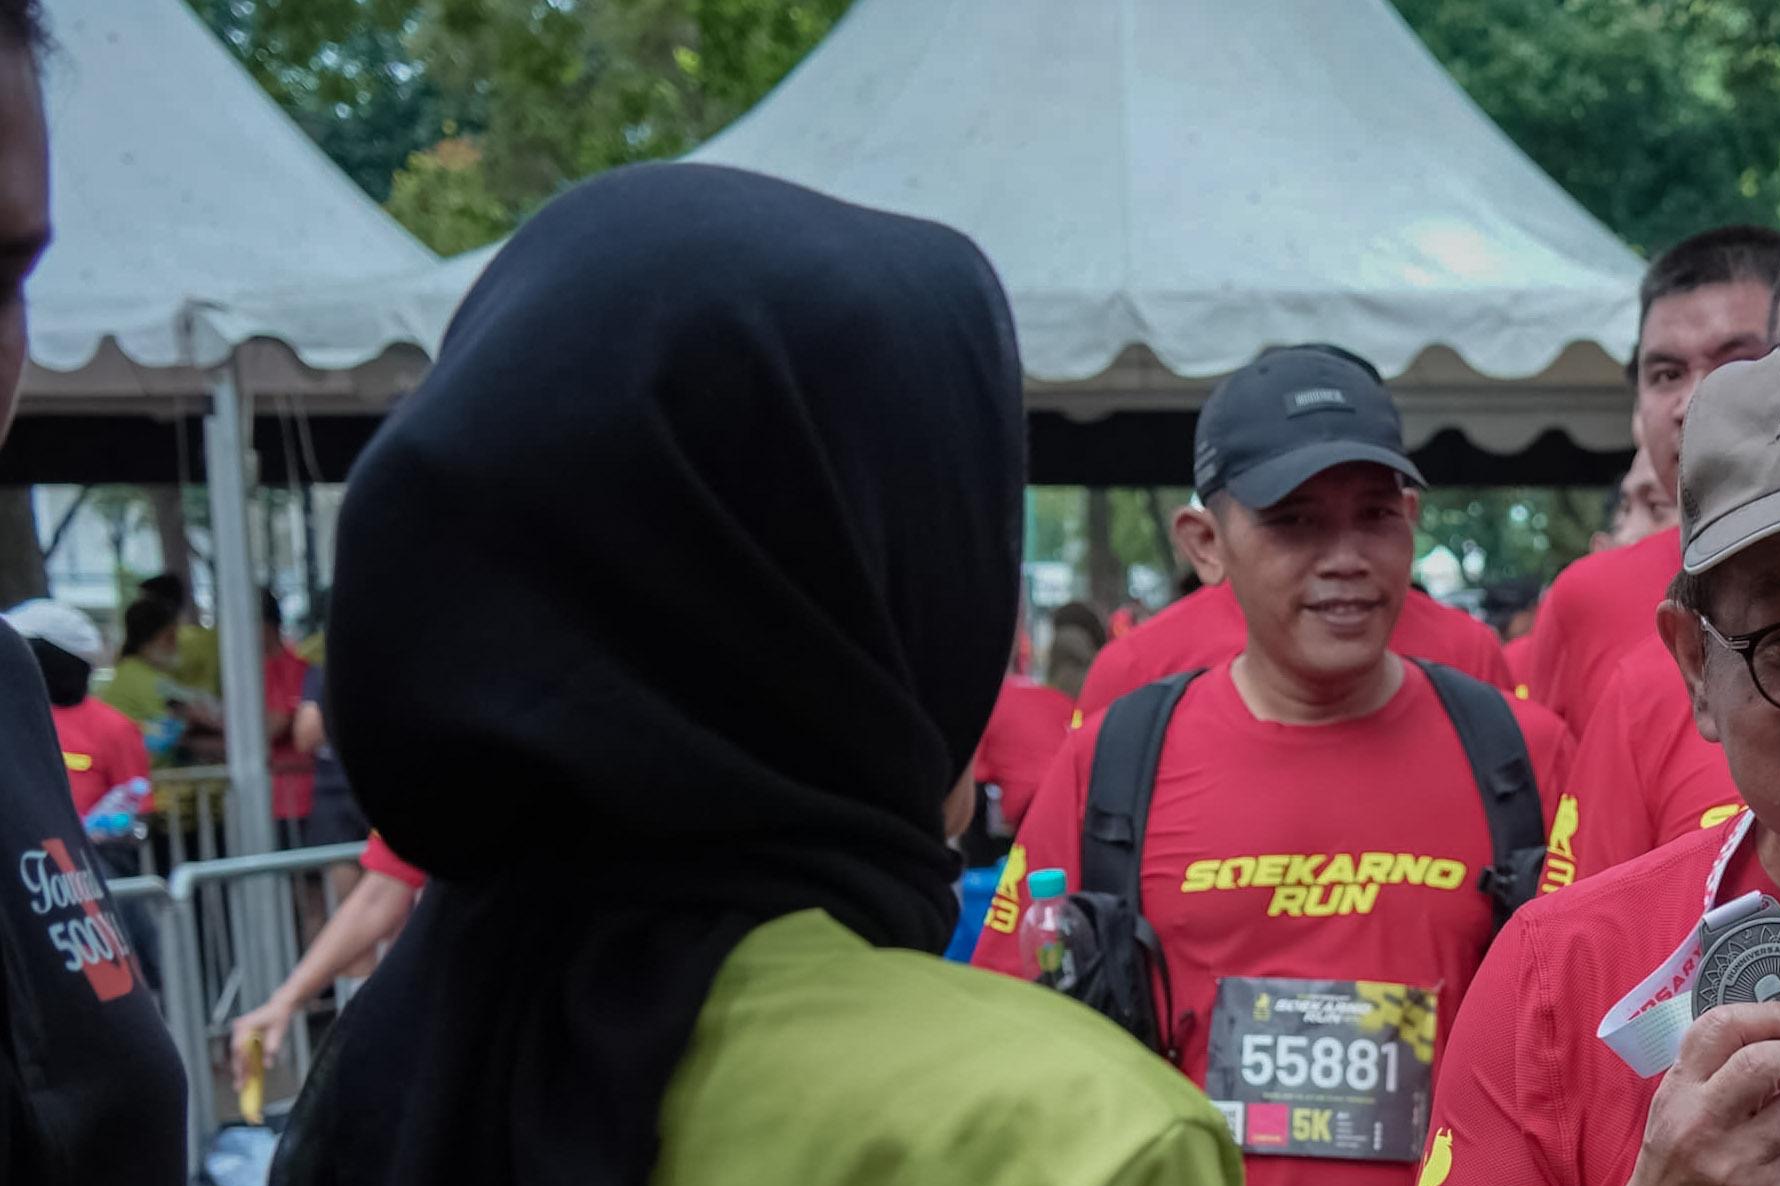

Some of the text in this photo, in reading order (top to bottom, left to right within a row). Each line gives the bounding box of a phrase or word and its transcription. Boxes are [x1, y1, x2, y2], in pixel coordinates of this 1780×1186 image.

[1180, 852, 1467, 893] SOEKARNO
[1267, 882, 1381, 917] RUN
[1240, 1033, 1398, 1093] 55881
[1291, 1107, 1334, 1143] 5K
